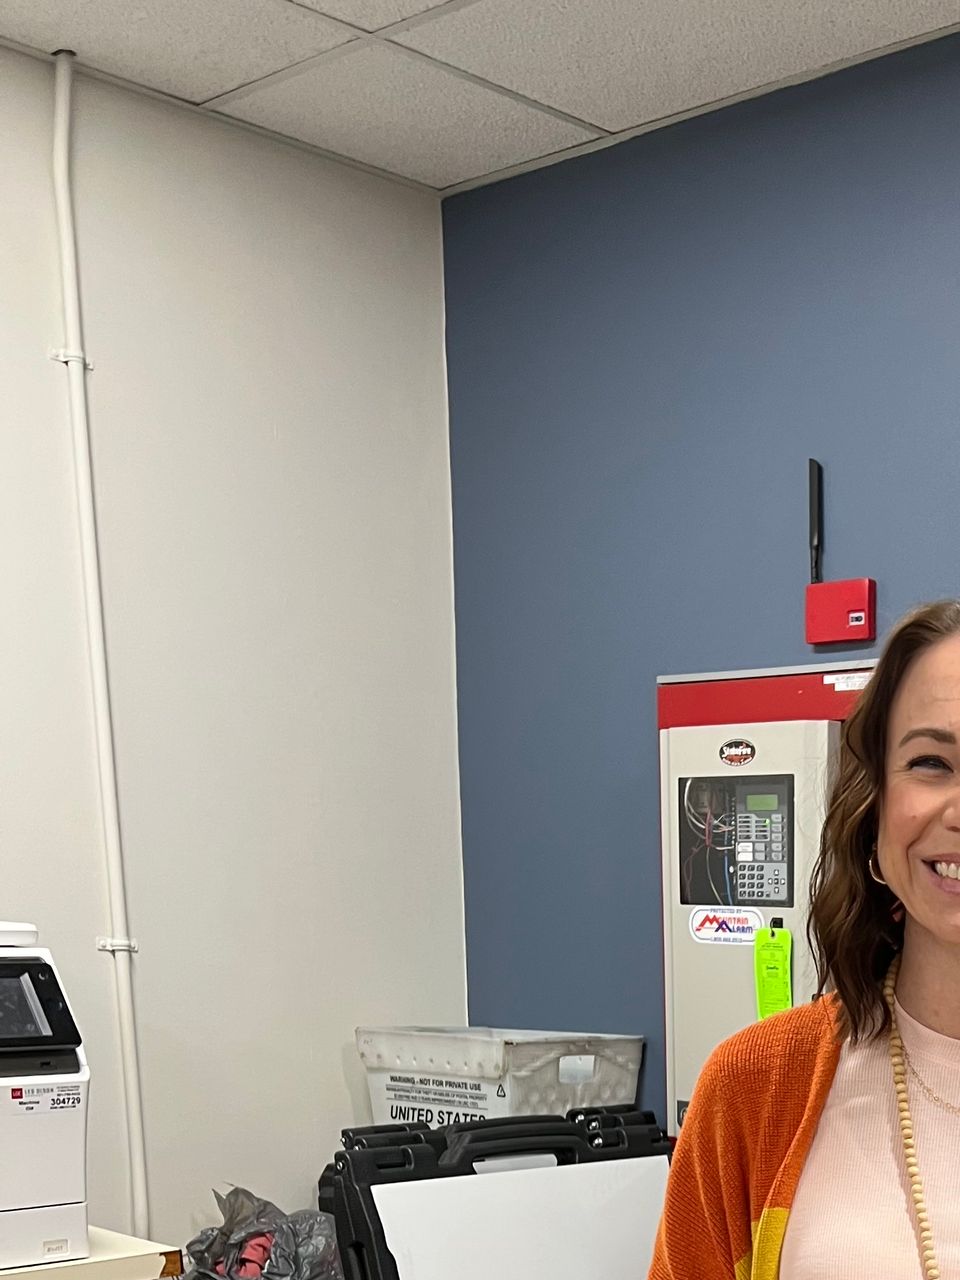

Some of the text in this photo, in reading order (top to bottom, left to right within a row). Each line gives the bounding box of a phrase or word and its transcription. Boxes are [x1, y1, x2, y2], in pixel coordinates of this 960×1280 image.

[715, 920, 753, 933] ALARM
[420, 1078, 431, 1086] NOT
[432, 1079, 443, 1087] FOR
[445, 1080, 467, 1089] PRIVATE
[469, 1083, 481, 1091] USE
[51, 1097, 80, 1105] 304729
[391, 1105, 433, 1123] UNITED
